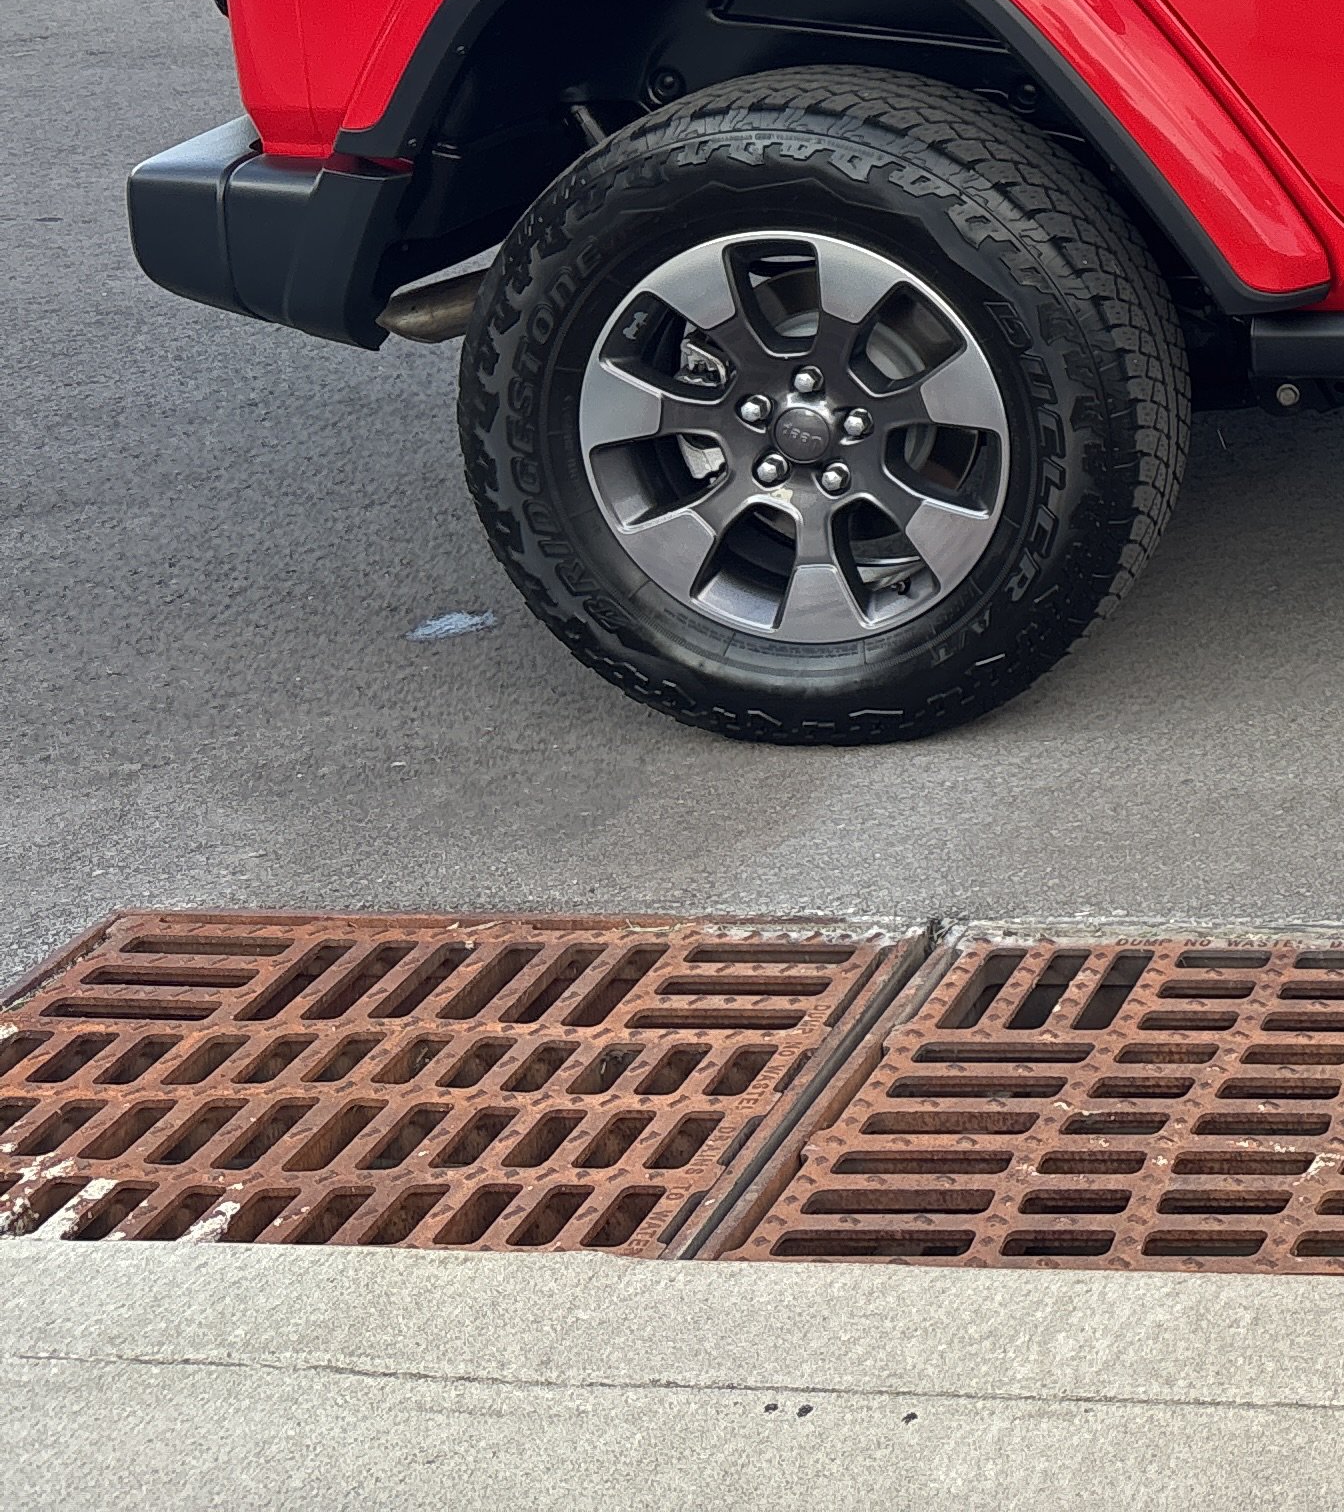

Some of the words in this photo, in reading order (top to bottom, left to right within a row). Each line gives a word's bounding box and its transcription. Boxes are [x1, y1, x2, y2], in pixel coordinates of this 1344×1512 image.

[506, 236, 634, 634] BRIDGESTONE
[983, 300, 1067, 604] DUELER
[1115, 938, 1172, 947] DUMP
[1184, 938, 1212, 947] NO
